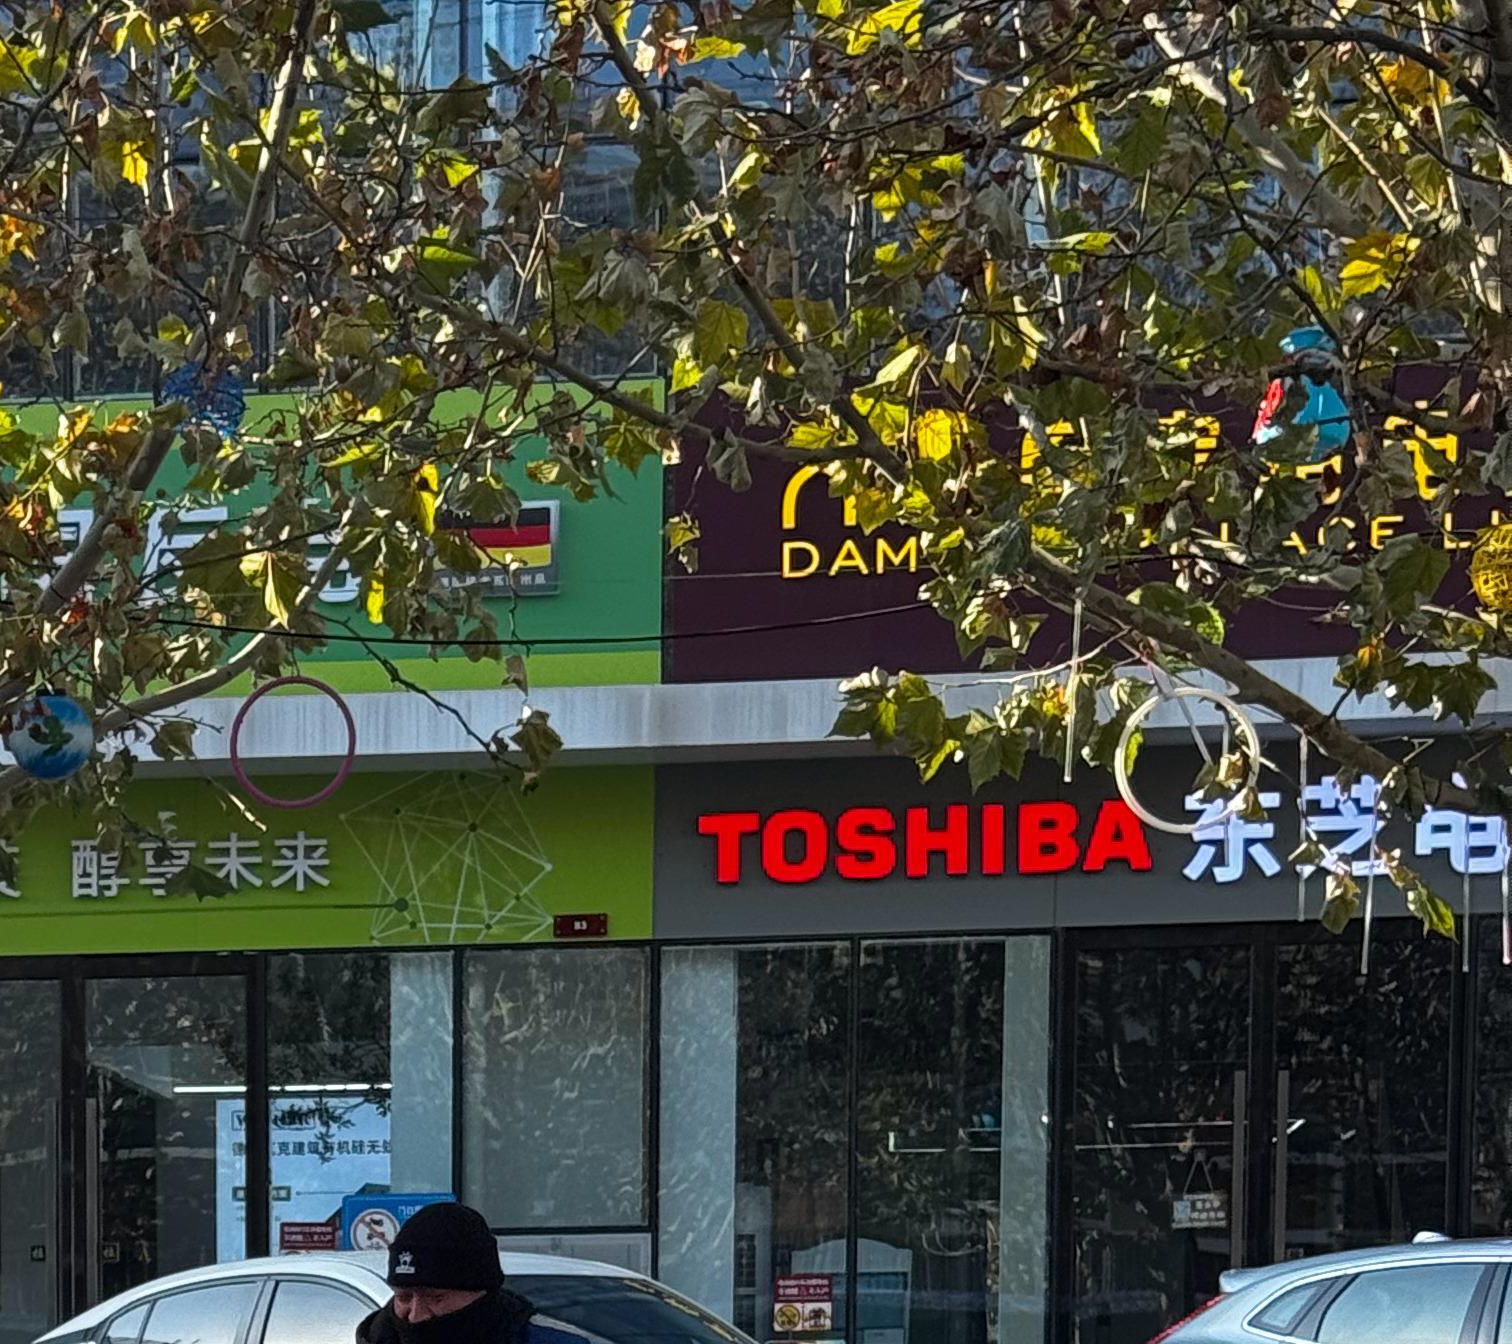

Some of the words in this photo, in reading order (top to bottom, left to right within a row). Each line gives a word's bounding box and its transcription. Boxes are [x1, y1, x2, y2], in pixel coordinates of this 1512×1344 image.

[781, 537, 920, 579] DAM
[70, 831, 332, 900] 醇享未来
[698, 800, 1152, 884] TOSHIBA
